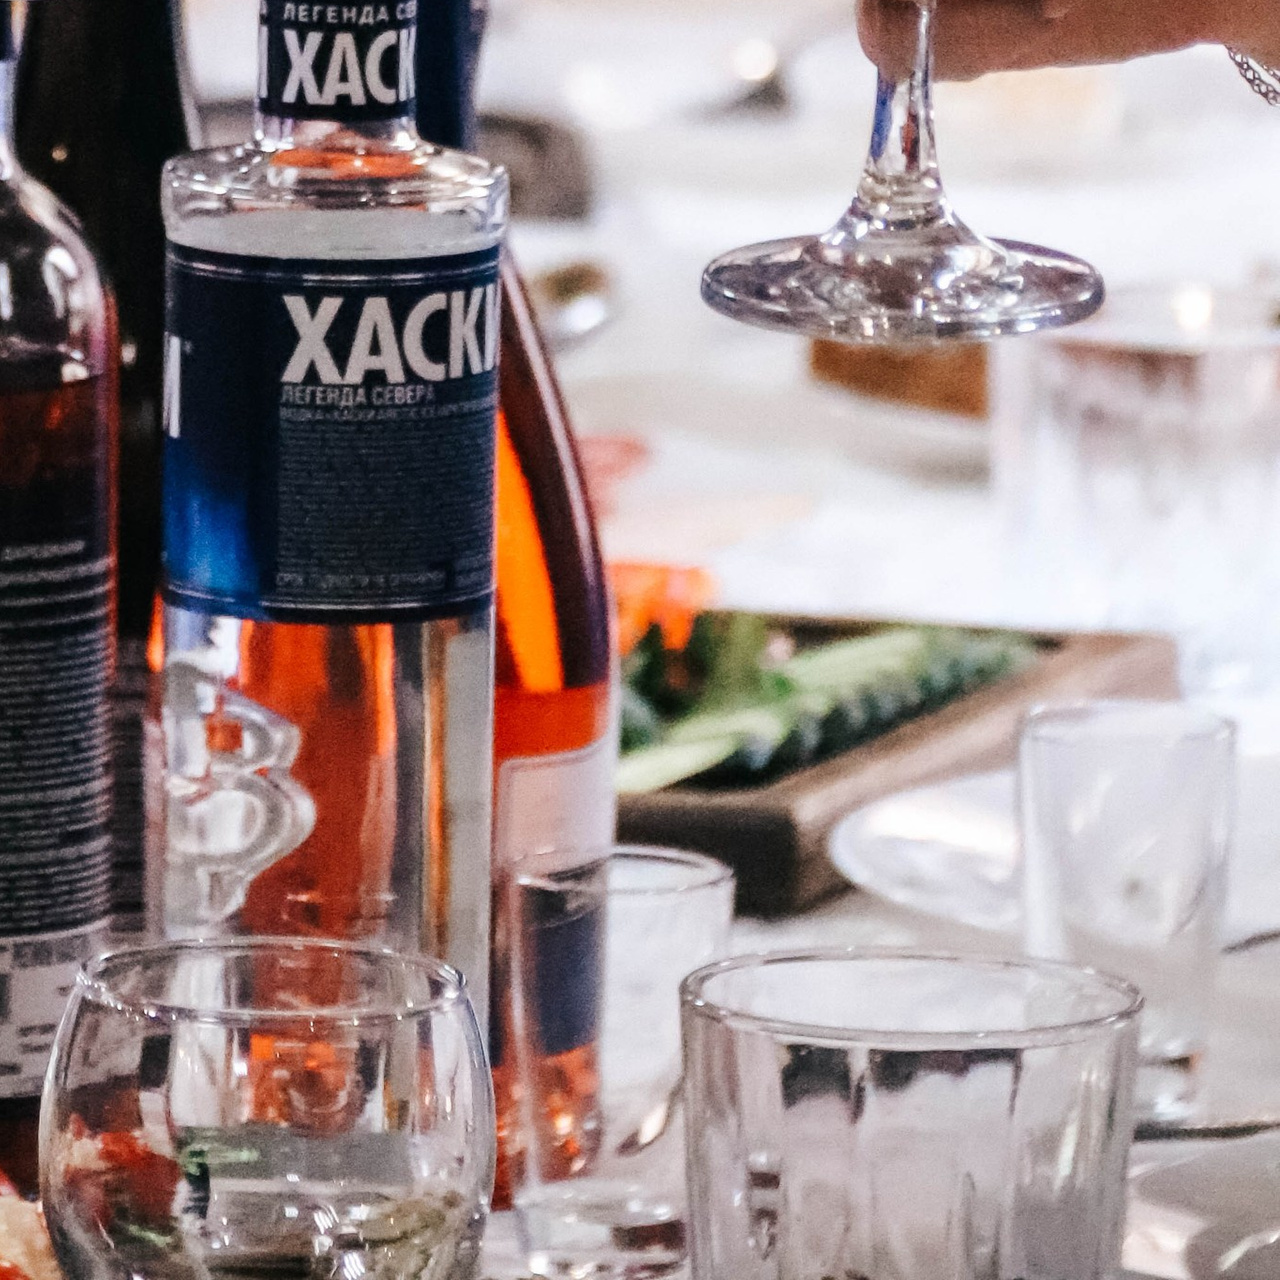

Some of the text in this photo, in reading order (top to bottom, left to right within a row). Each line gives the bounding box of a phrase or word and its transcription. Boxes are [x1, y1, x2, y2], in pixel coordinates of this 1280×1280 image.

[283, 2, 389, 25] ЛЕГЕНДА
[281, 384, 436, 407] ЛЕГЕНДА СЕВЕРА
